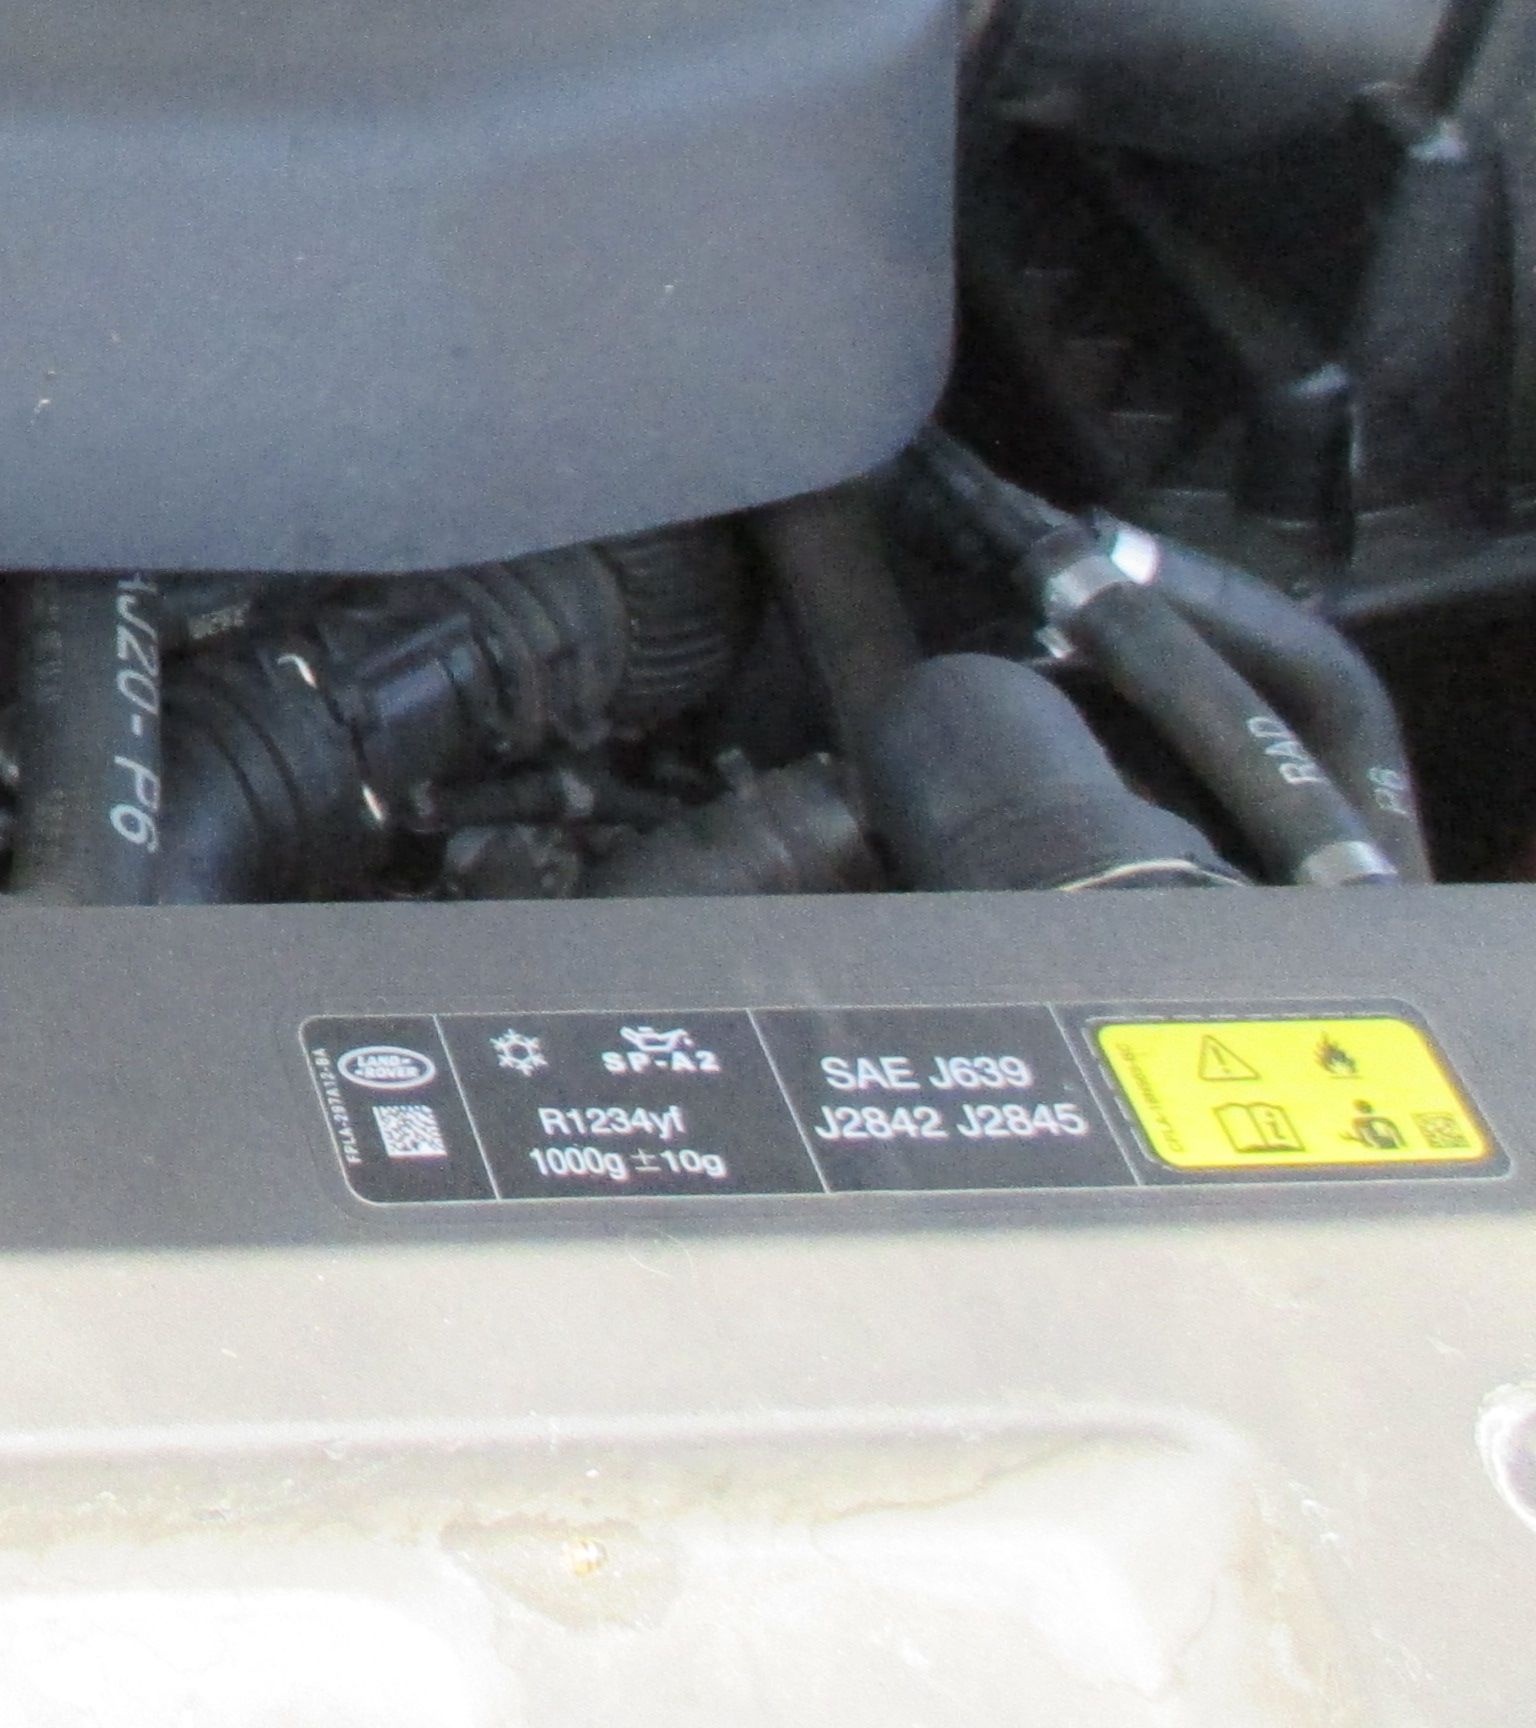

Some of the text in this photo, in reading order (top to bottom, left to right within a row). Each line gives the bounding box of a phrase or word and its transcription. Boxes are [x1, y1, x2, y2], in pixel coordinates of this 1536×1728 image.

[1247, 716, 1326, 785] RAD
[357, 1055, 402, 1067] LAND
[364, 1066, 420, 1080] ROVER
[601, 1051, 721, 1073] SP-A2
[820, 1055, 1033, 1090] SAE J639
[537, 1104, 686, 1141] R1234yf
[814, 1103, 1089, 1140] J2842 J2845
[529, 1146, 628, 1182] 1000g
